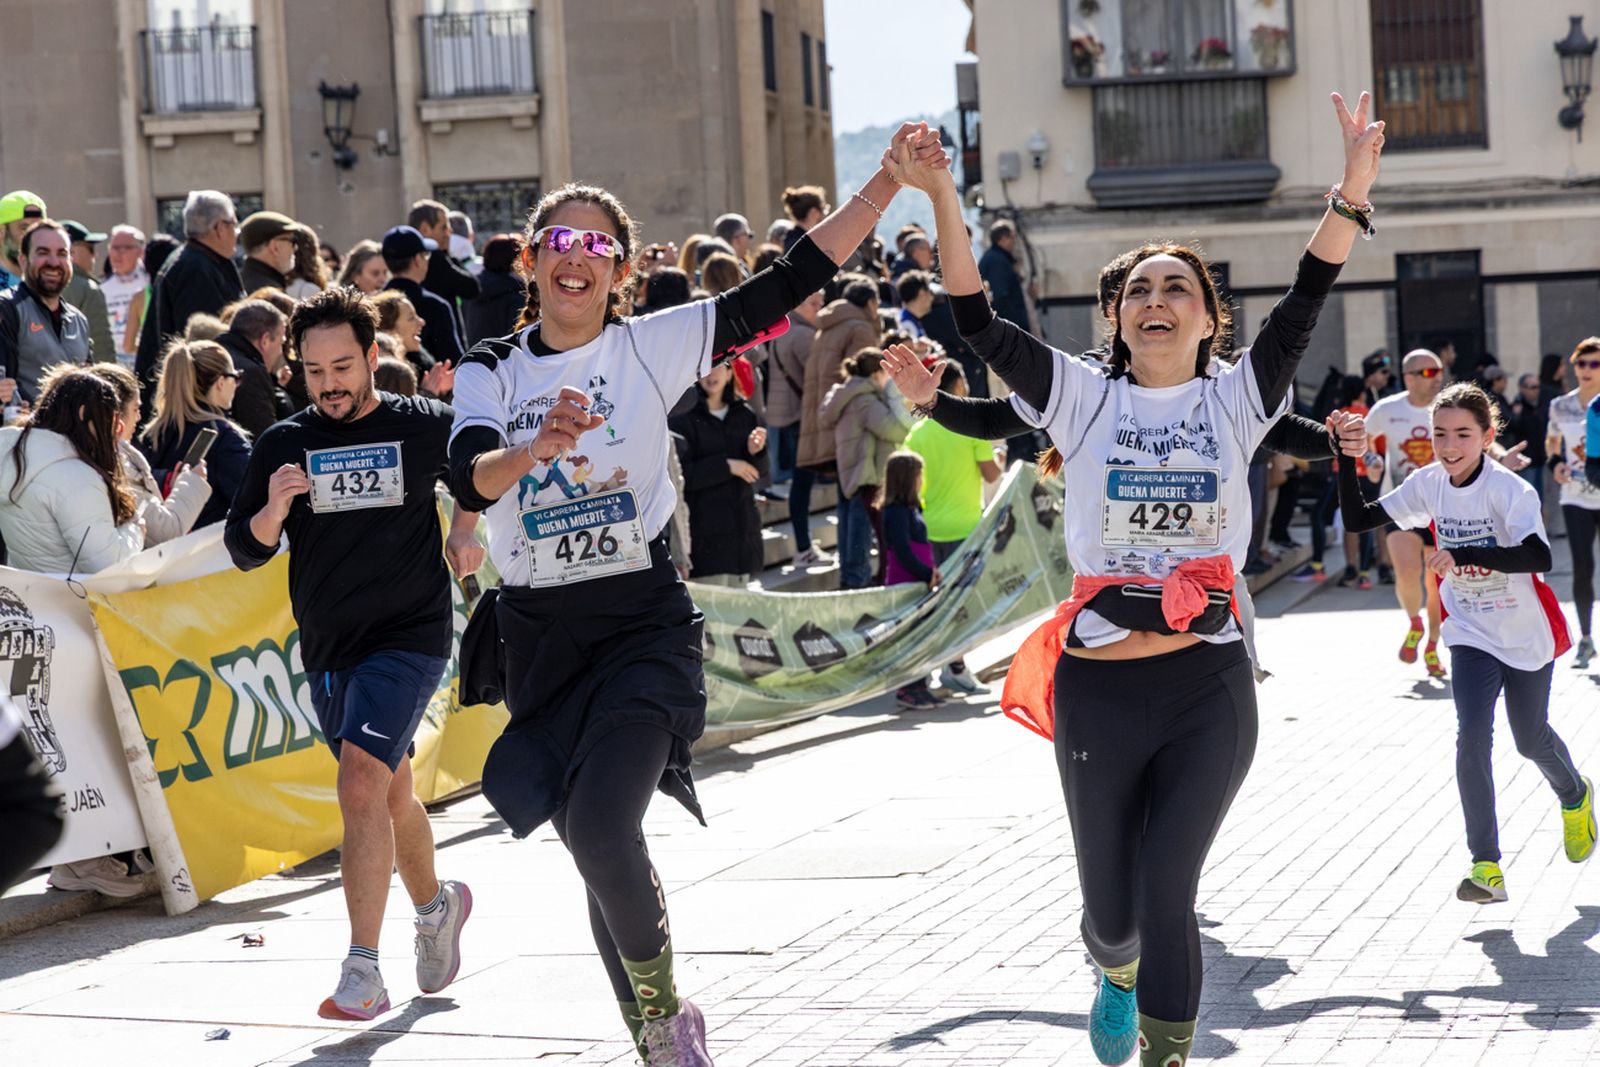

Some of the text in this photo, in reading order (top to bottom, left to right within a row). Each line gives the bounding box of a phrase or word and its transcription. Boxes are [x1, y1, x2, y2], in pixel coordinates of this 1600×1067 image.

[519, 396, 557, 411] CARRE
[320, 458, 375, 472] BUENA MUERTE
[327, 452, 355, 460] CARRERA
[355, 448, 388, 457] CAMINATA
[331, 469, 382, 496] 432
[1119, 474, 1206, 484] VI CARRERA CAMINATA
[1118, 484, 1187, 499] BUENA MUERTE
[543, 504, 580, 519] CARRERA
[580, 495, 622, 511] CAMINATA
[1129, 502, 1193, 531] 429
[536, 509, 608, 535] BUENA MUERTE
[555, 526, 619, 564] 426
[71, 783, 106, 812] JAÉN
